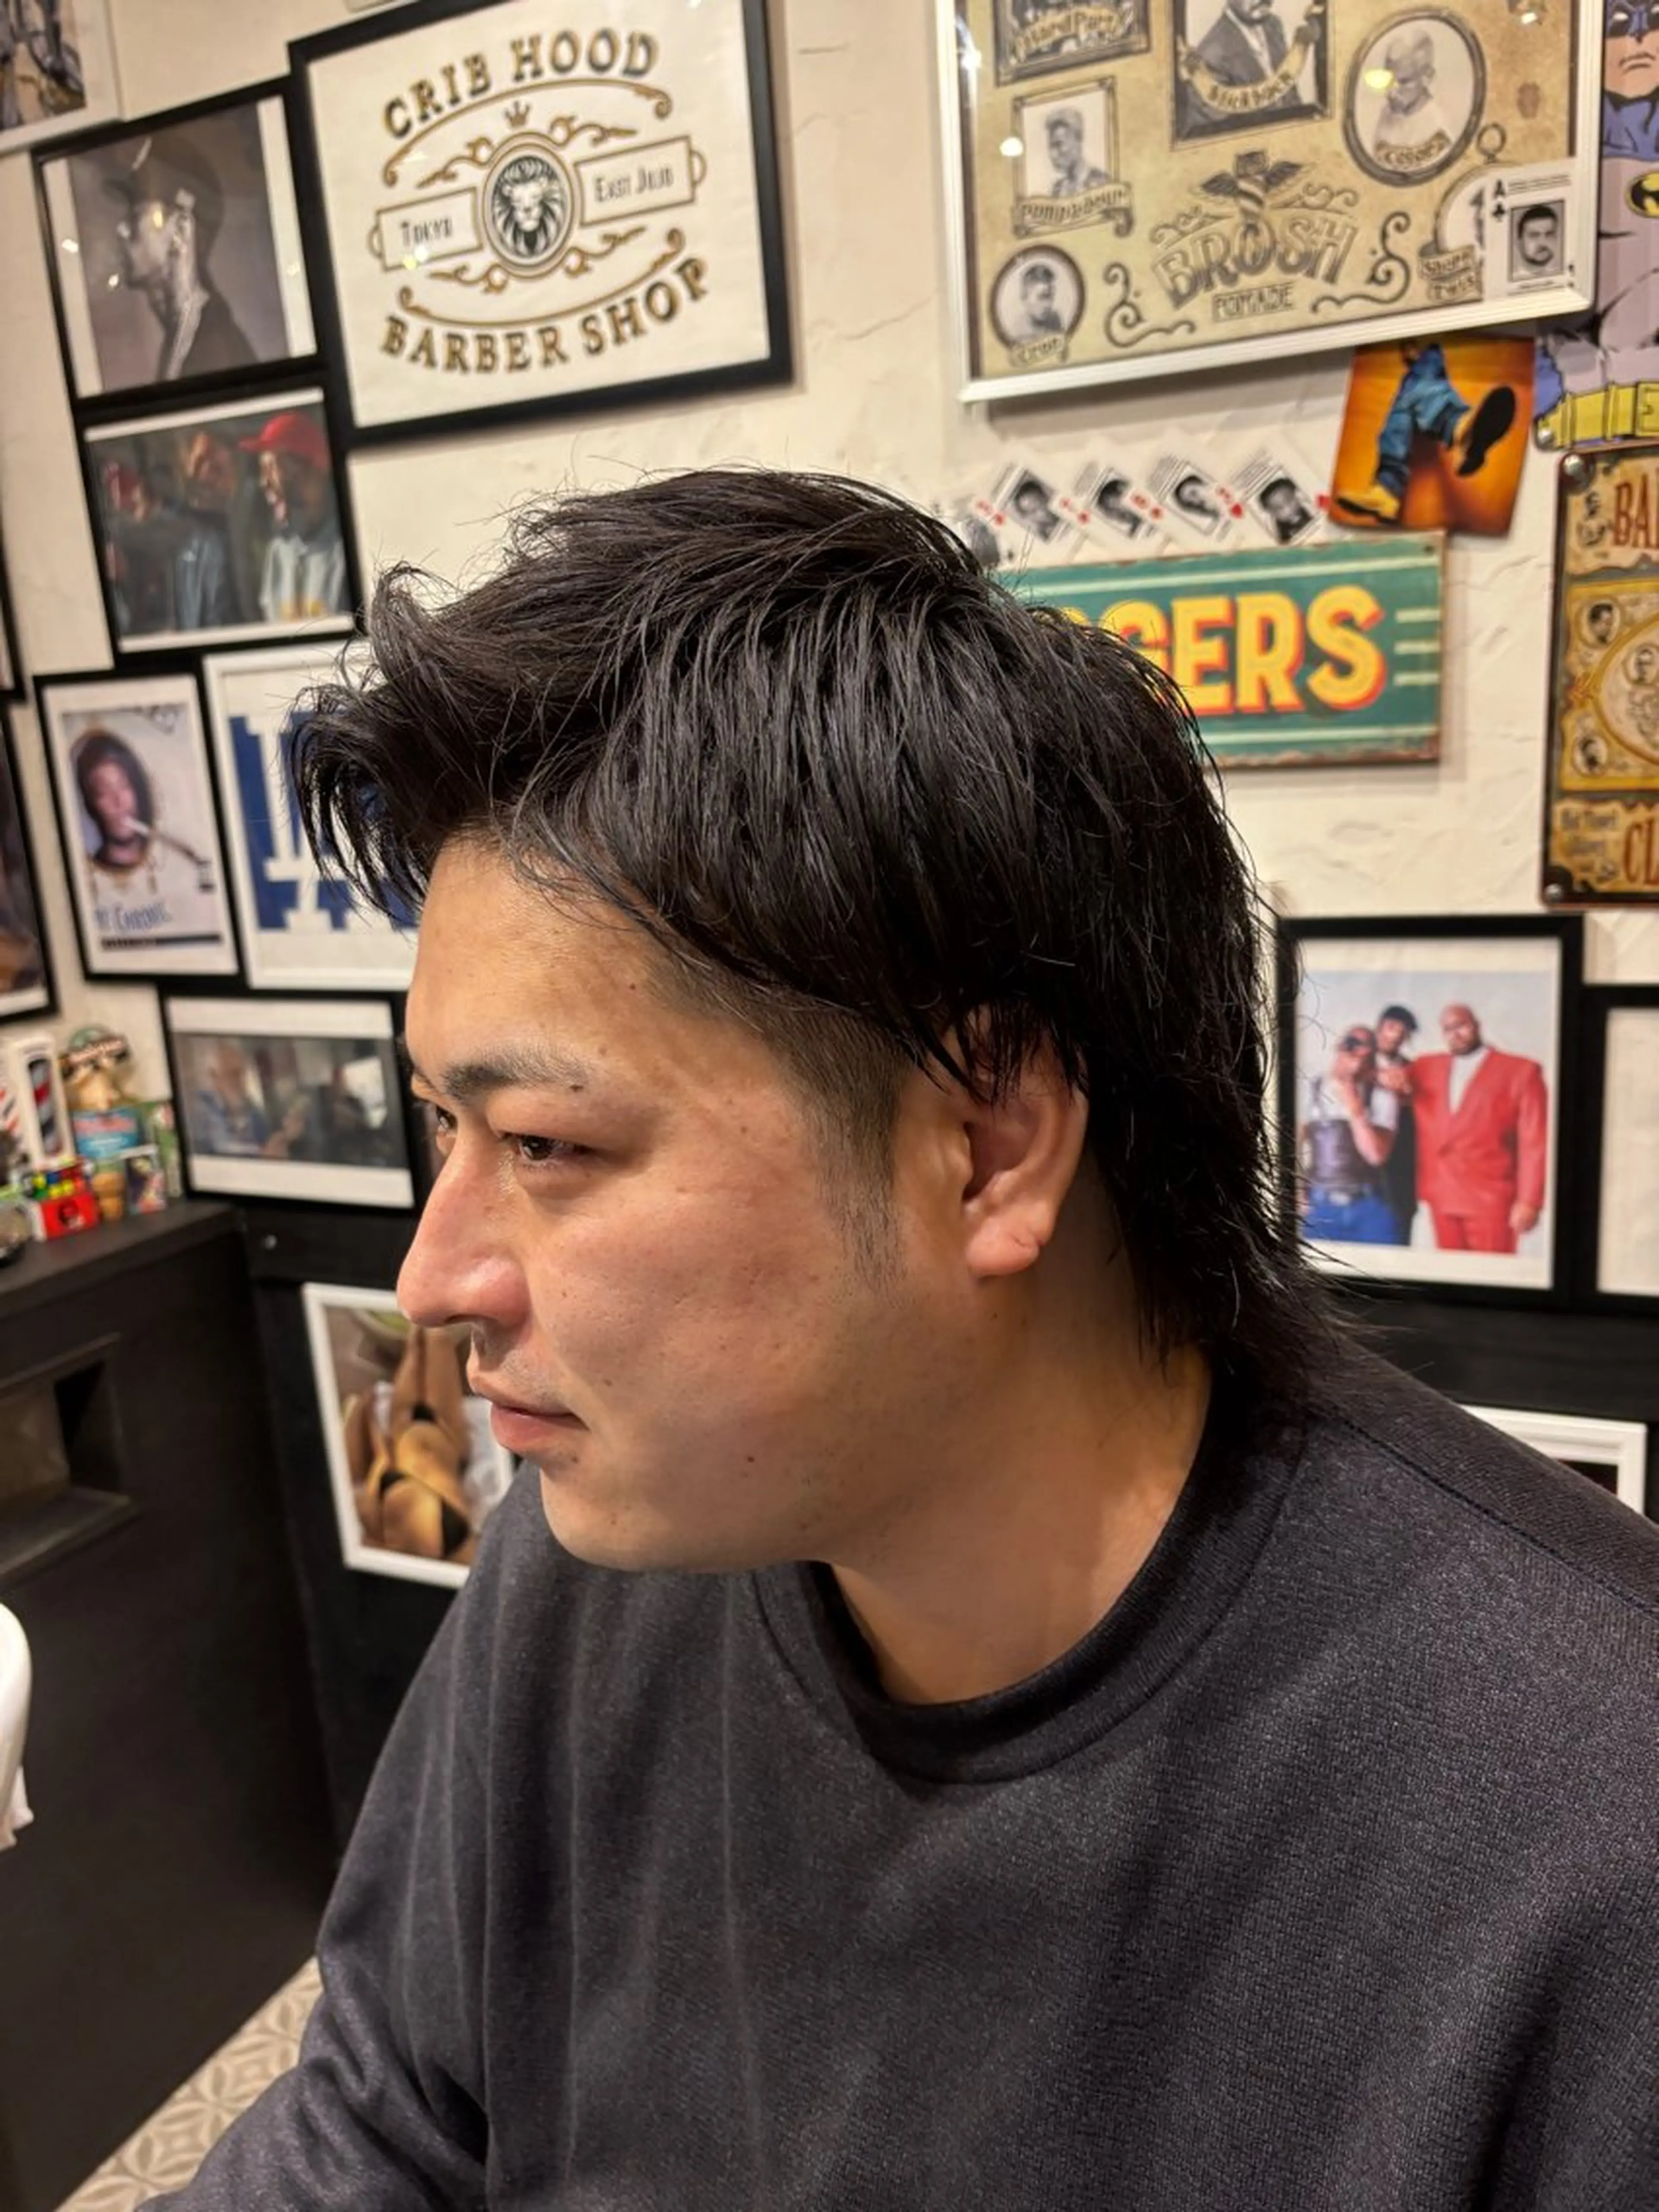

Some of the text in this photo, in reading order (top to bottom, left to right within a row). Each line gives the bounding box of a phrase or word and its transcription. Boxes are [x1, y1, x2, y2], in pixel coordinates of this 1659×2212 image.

[384, 29, 658, 139] CRIB HOOD
[1492, 178, 1506, 197] A
[382, 258, 709, 374] BARBER SHOP
[1614, 467, 1659, 548] BA
[1052, 585, 1388, 715] GERS
